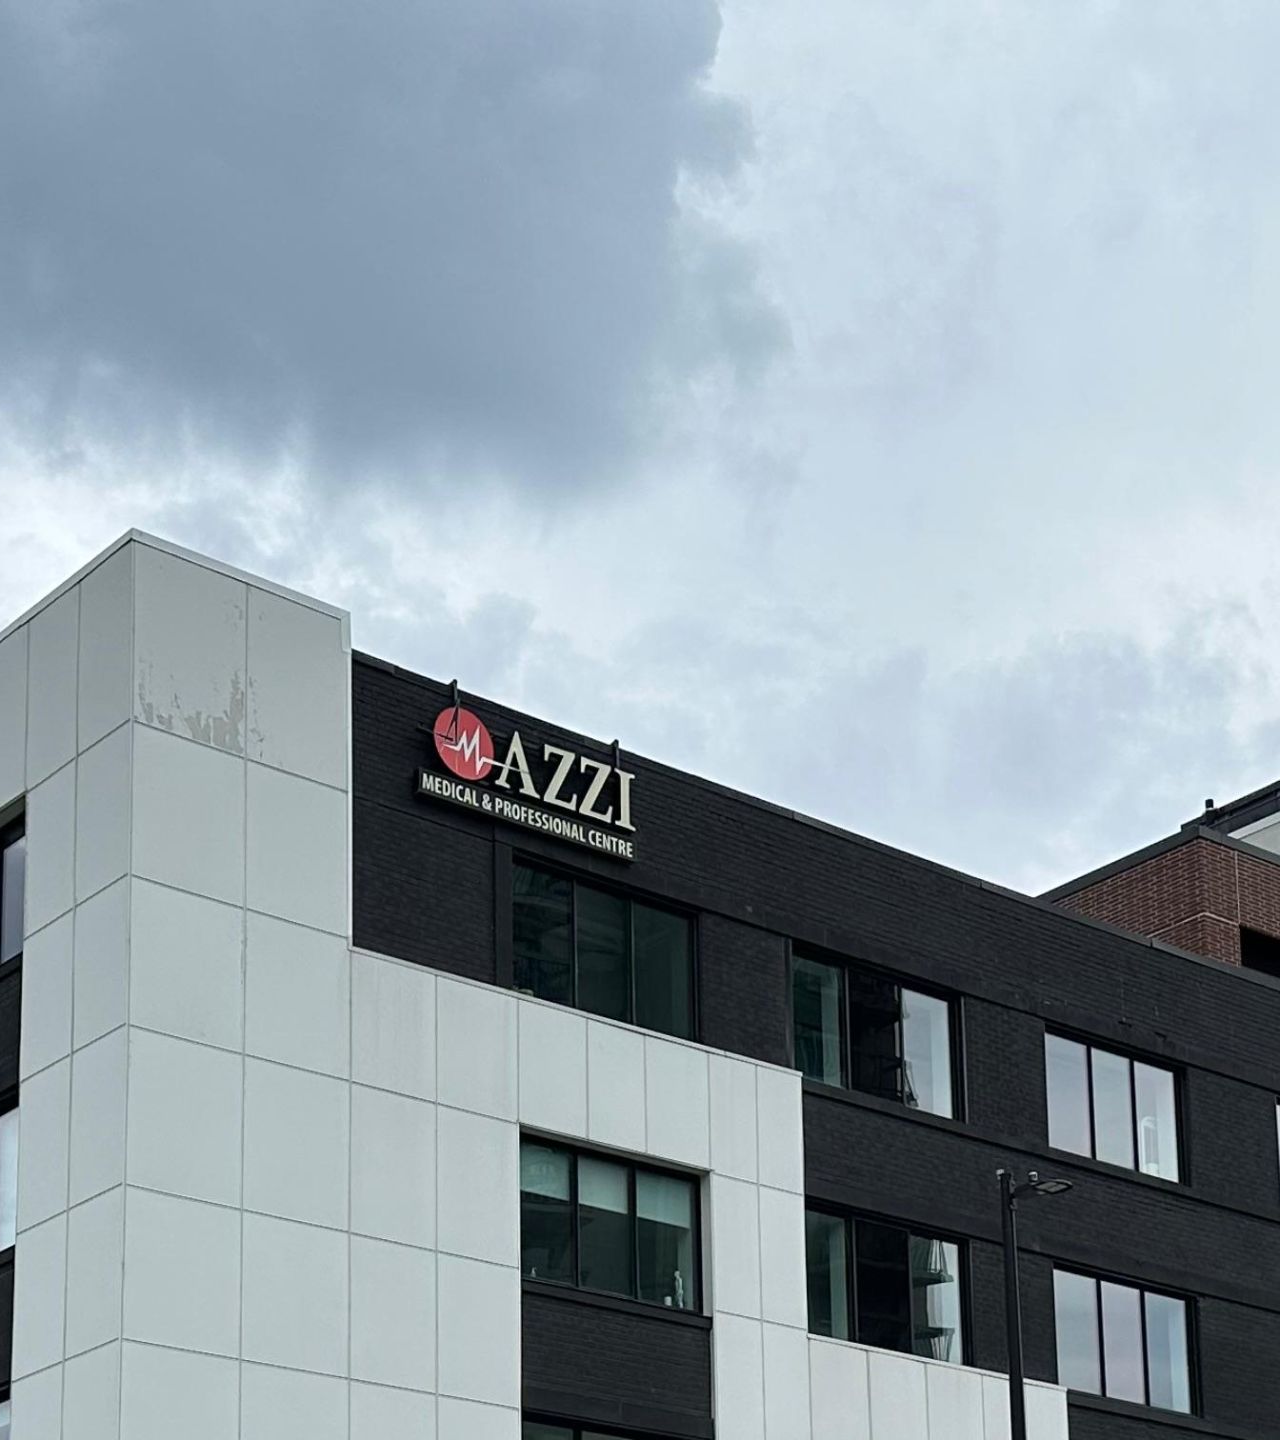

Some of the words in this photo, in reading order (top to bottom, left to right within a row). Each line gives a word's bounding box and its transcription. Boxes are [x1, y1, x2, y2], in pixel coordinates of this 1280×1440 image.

[422, 773, 479, 807] MEDICAL
[482, 793, 492, 811] &
[495, 798, 586, 843] PROFESSIONAL
[588, 830, 633, 858] CENTRE
